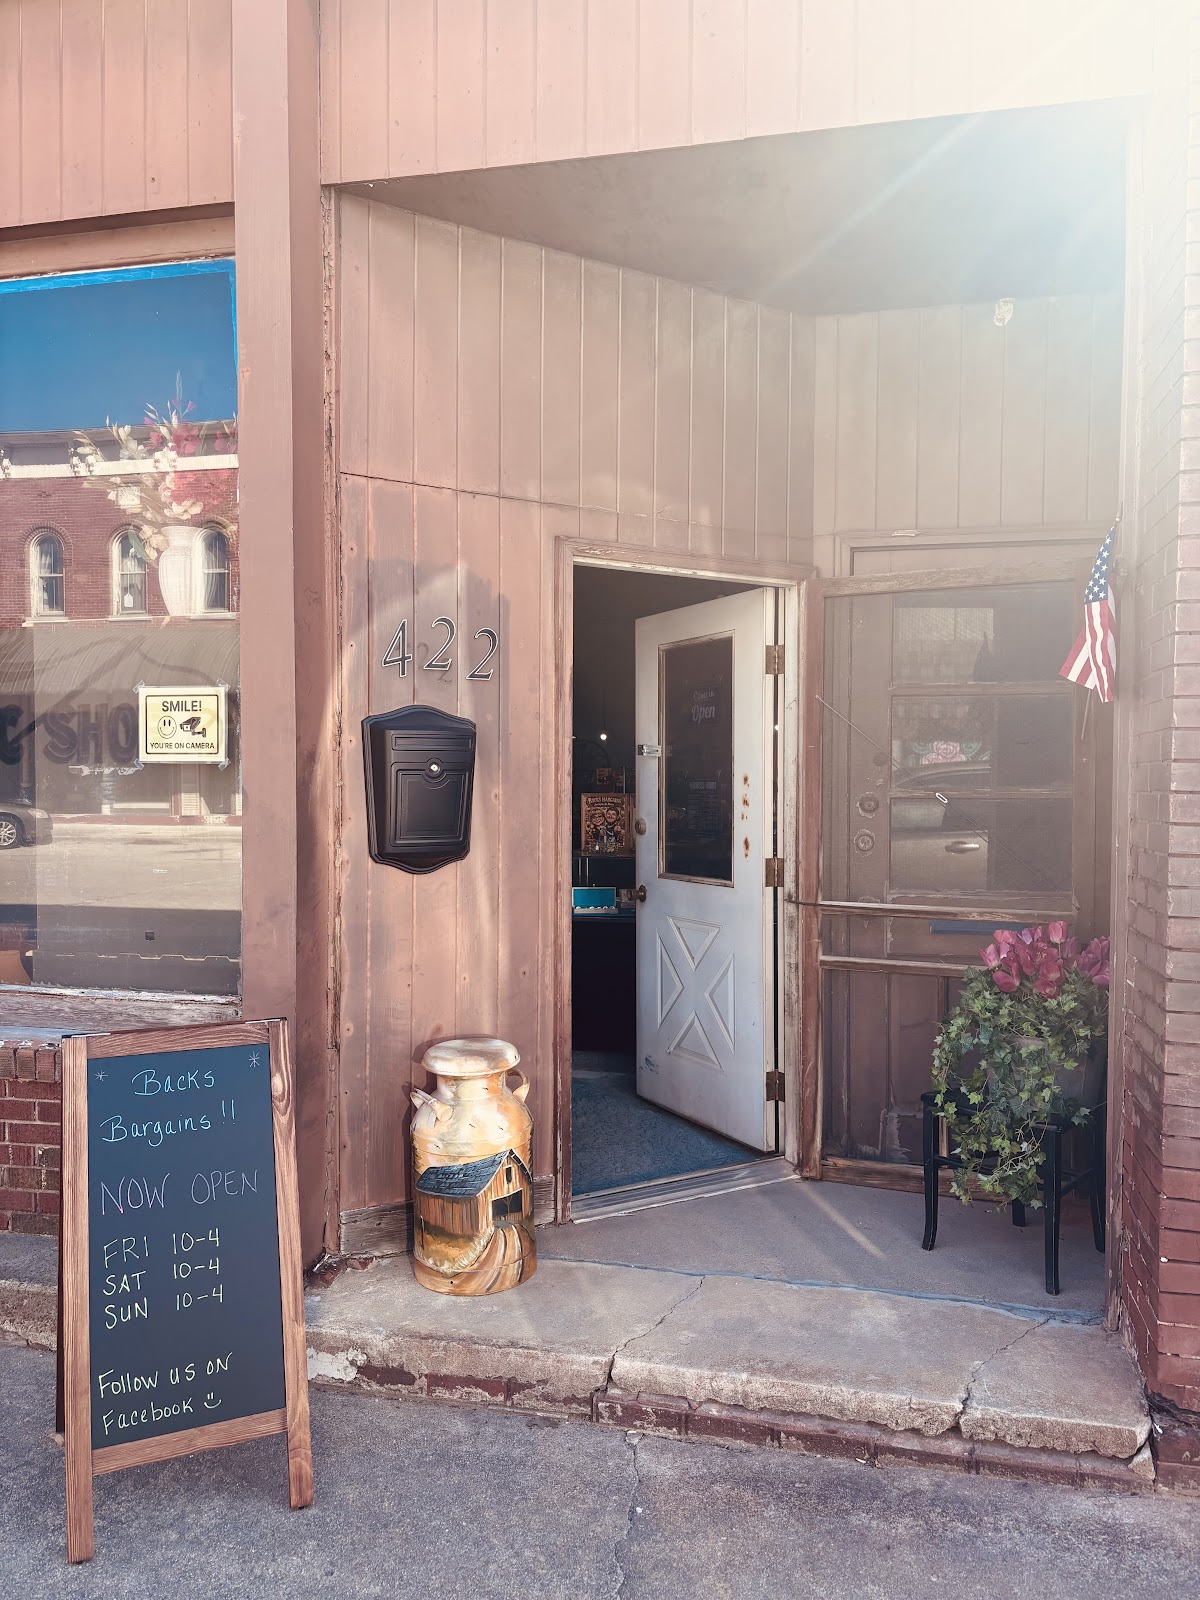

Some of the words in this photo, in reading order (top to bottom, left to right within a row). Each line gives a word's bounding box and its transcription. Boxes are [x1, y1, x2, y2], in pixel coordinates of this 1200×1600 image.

[381, 616, 499, 681] 422
[161, 700, 202, 712] SMILE!
[691, 704, 715, 723] Open
[43, 703, 139, 765] SHO
[100, 1172, 171, 1215] NOW
[191, 1169, 258, 1204] OPEN
[103, 1236, 149, 1268] FRI
[172, 1227, 220, 1254] 10-4
[102, 1270, 147, 1296] SAT
[173, 1257, 220, 1280] 10-4
[104, 1297, 149, 1330] SUN
[176, 1284, 223, 1311] 10-4
[98, 1369, 159, 1399] Follow
